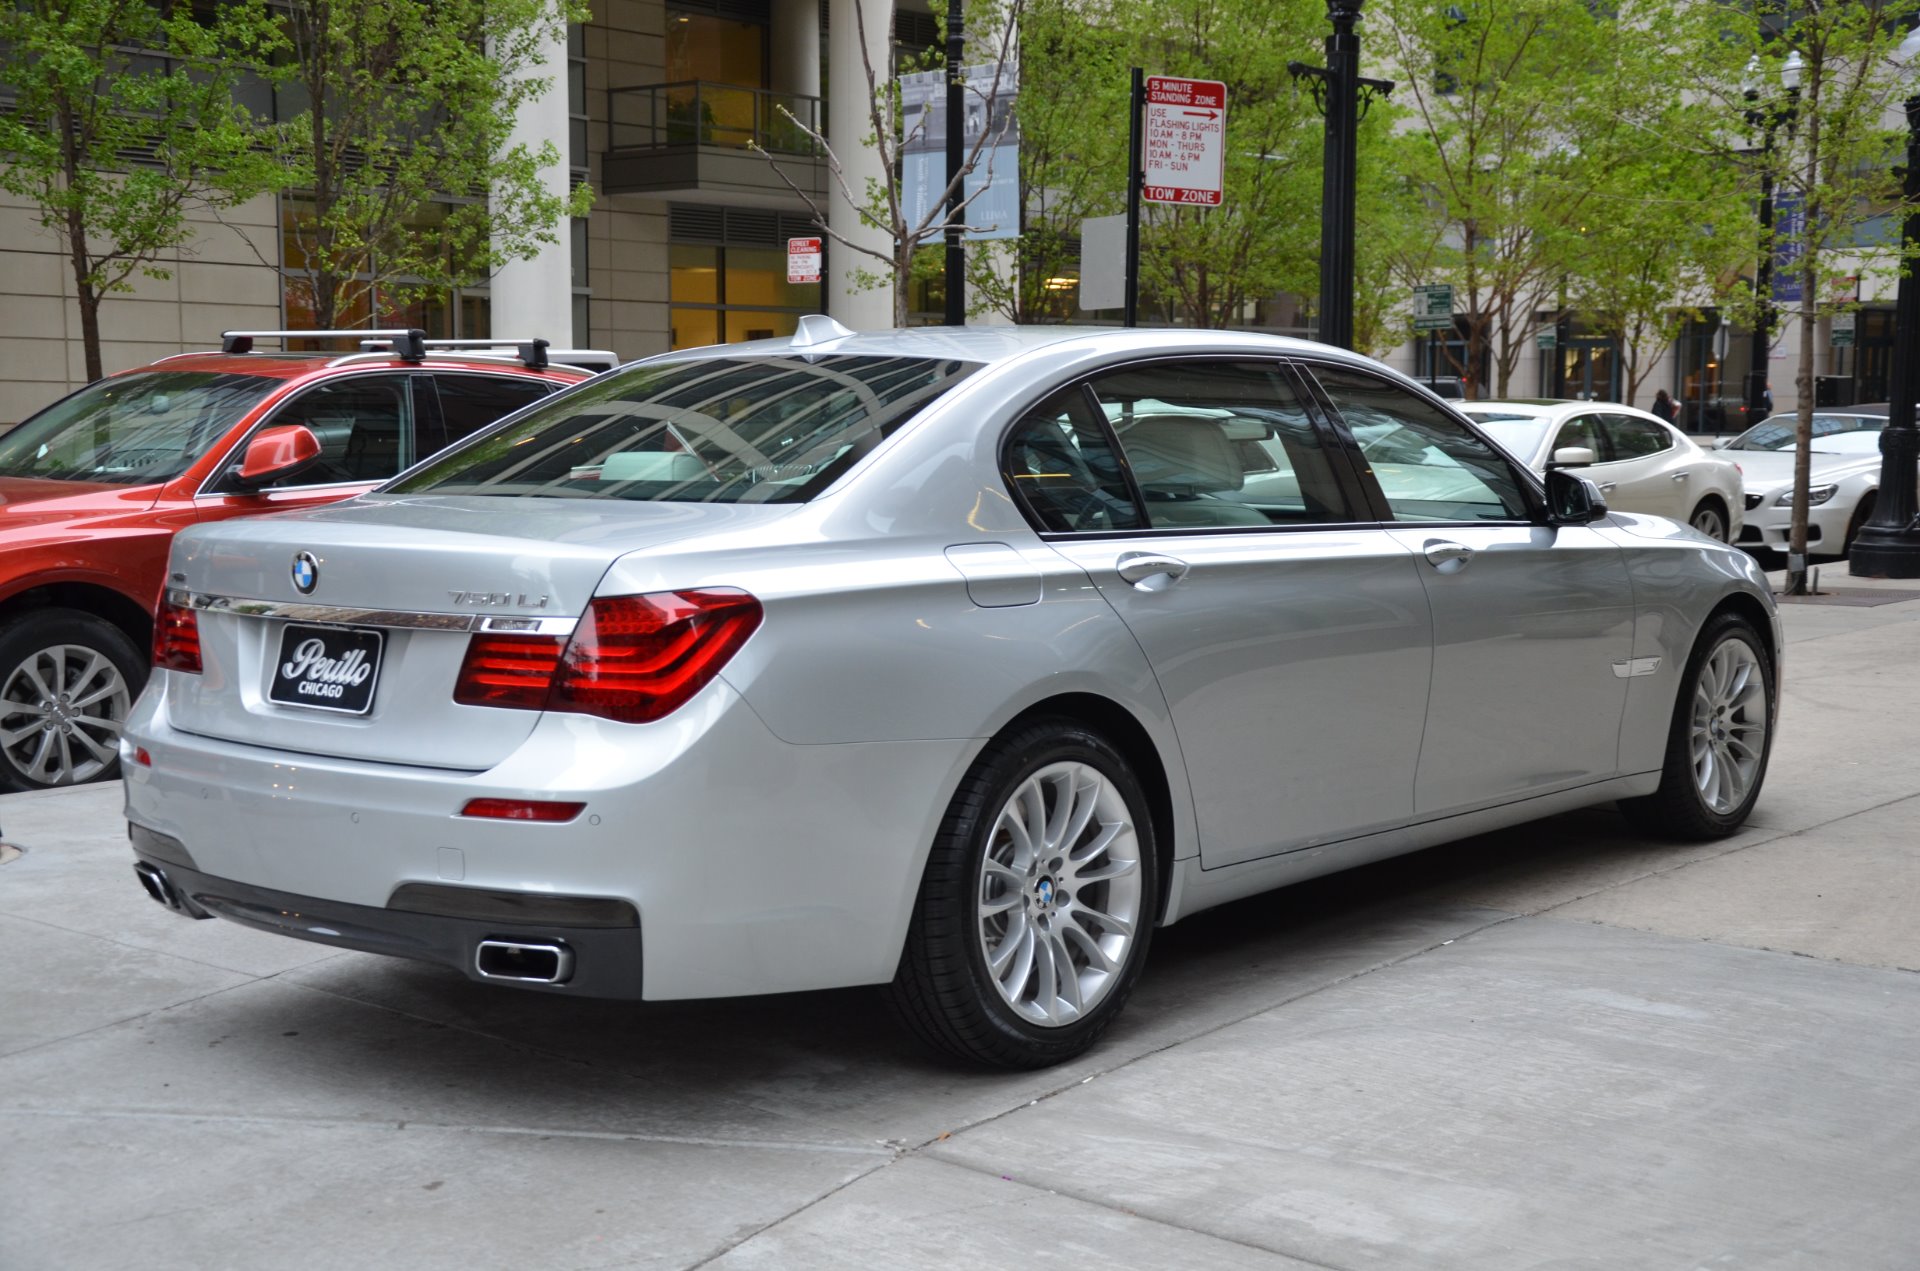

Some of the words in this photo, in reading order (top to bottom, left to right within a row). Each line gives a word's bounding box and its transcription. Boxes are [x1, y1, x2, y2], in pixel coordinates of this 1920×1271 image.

[1151, 81, 1160, 89] 15
[1162, 81, 1193, 93] MINUTE
[1151, 92, 1191, 104] STANDING
[1195, 95, 1216, 106] ZONE
[1151, 108, 1167, 118] USE
[1150, 119, 1190, 130] FLASHING
[1191, 122, 1220, 133] LIGHTS
[1181, 131, 1187, 140] 8
[1189, 132, 1202, 141] PM
[1150, 139, 1168, 149] MON
[1178, 141, 1205, 151] THURS
[1180, 151, 1186, 160] 6
[1188, 152, 1200, 161] PM
[1149, 159, 1163, 169] FRI
[1170, 162, 1188, 171] SUN
[1149, 187, 1175, 200] TOW
[1181, 189, 1214, 203] ZONE
[282, 638, 371, 686] Perillo
[298, 681, 344, 698] CHICAGO
